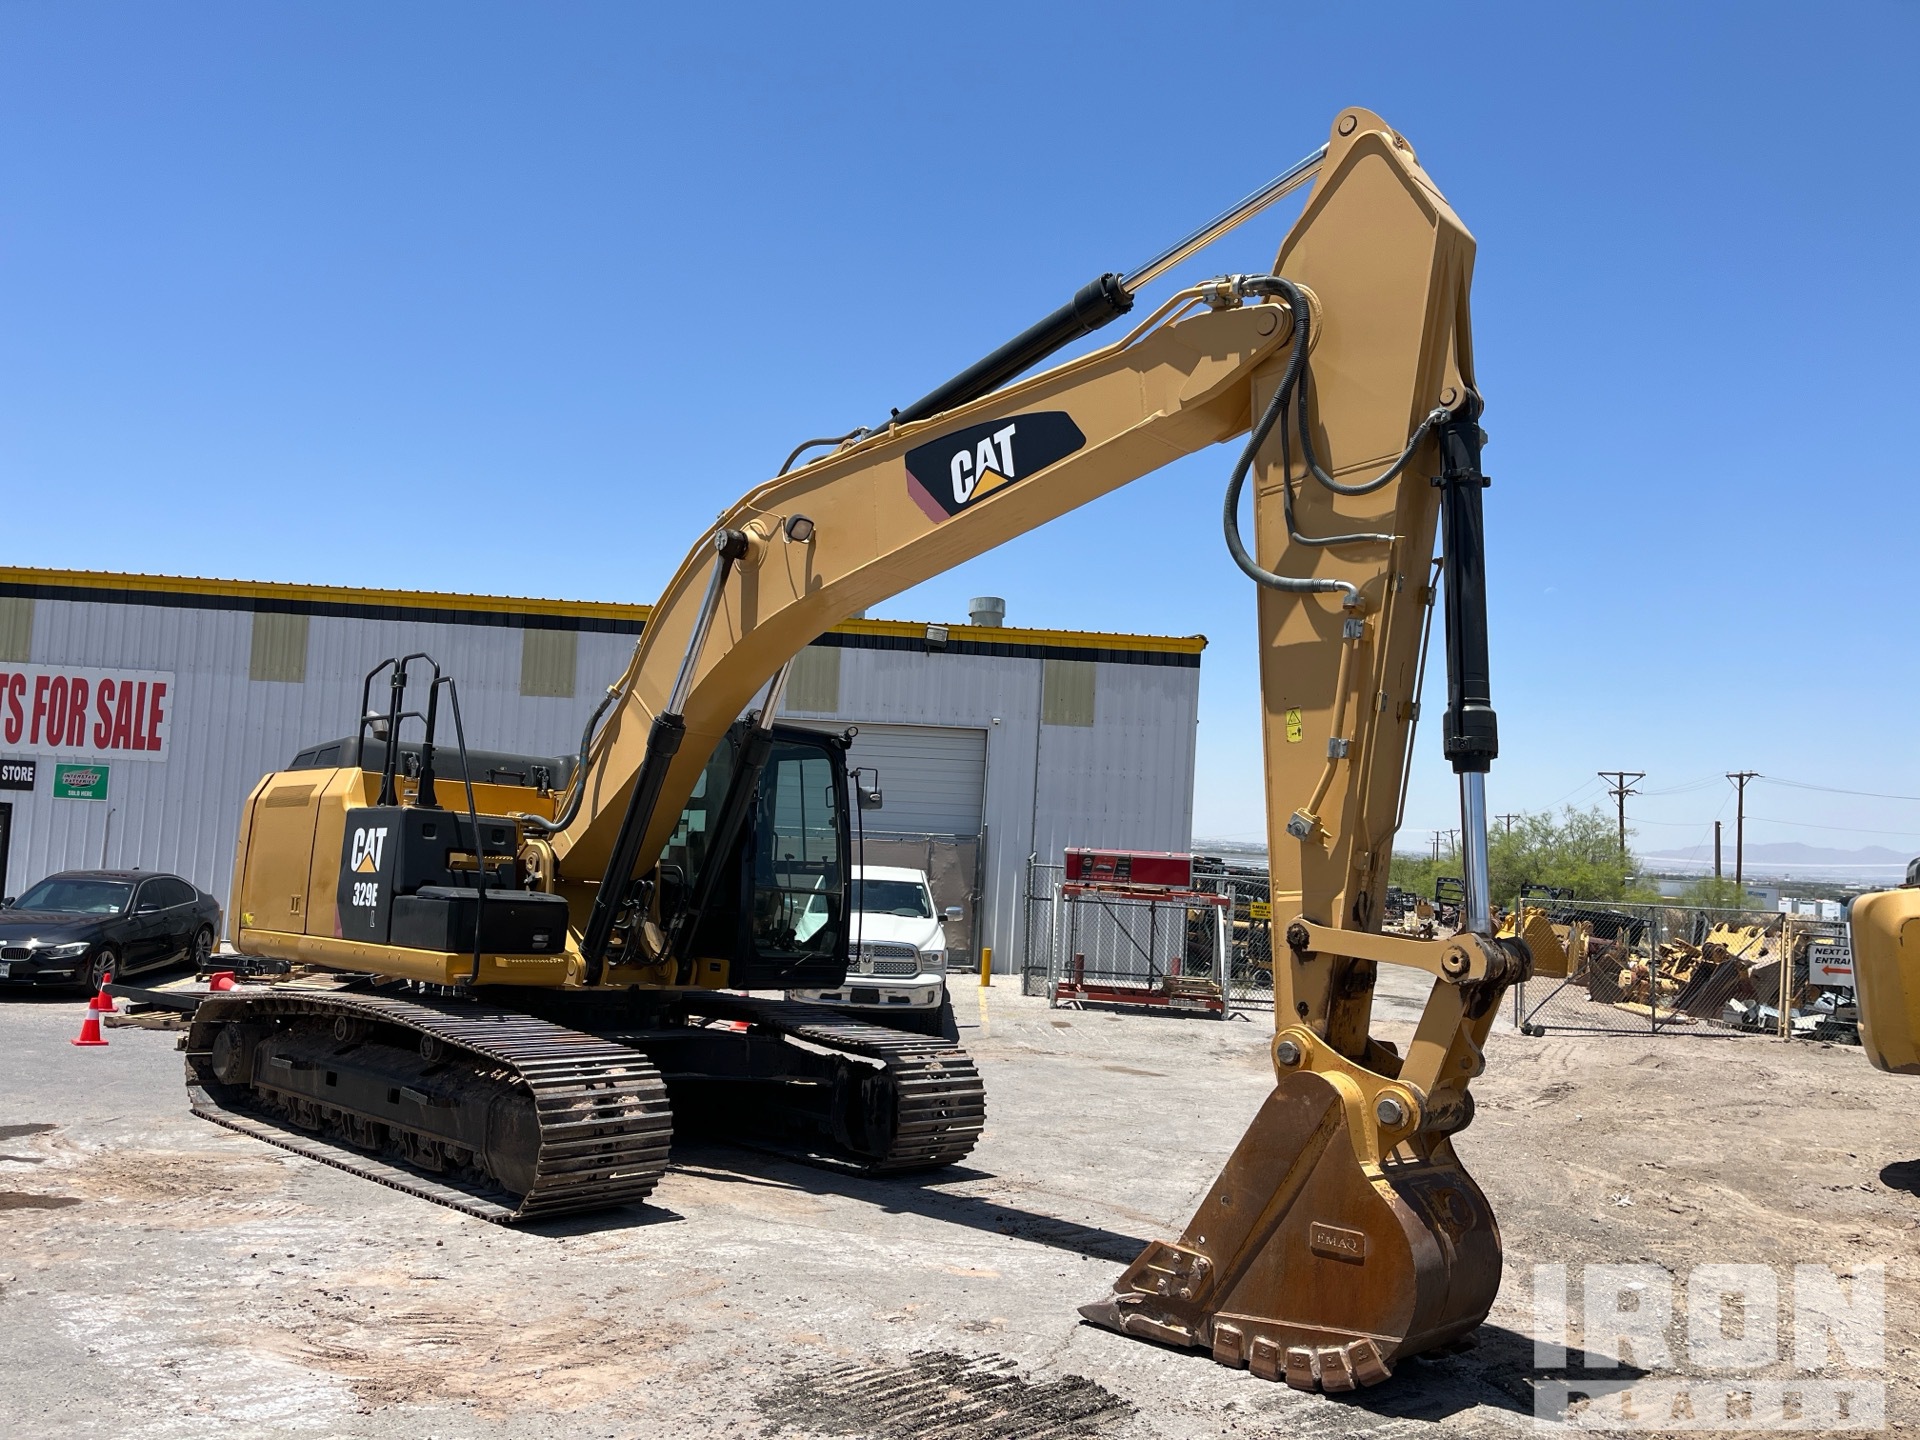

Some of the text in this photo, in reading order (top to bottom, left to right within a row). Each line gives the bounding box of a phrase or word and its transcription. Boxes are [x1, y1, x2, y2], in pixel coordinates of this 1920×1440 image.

[950, 423, 1016, 504] CAT
[30, 675, 90, 748] FOR
[93, 678, 167, 752] SALE
[2, 765, 34, 782] STORE
[351, 827, 388, 872] CAT
[352, 882, 379, 907] 329E
